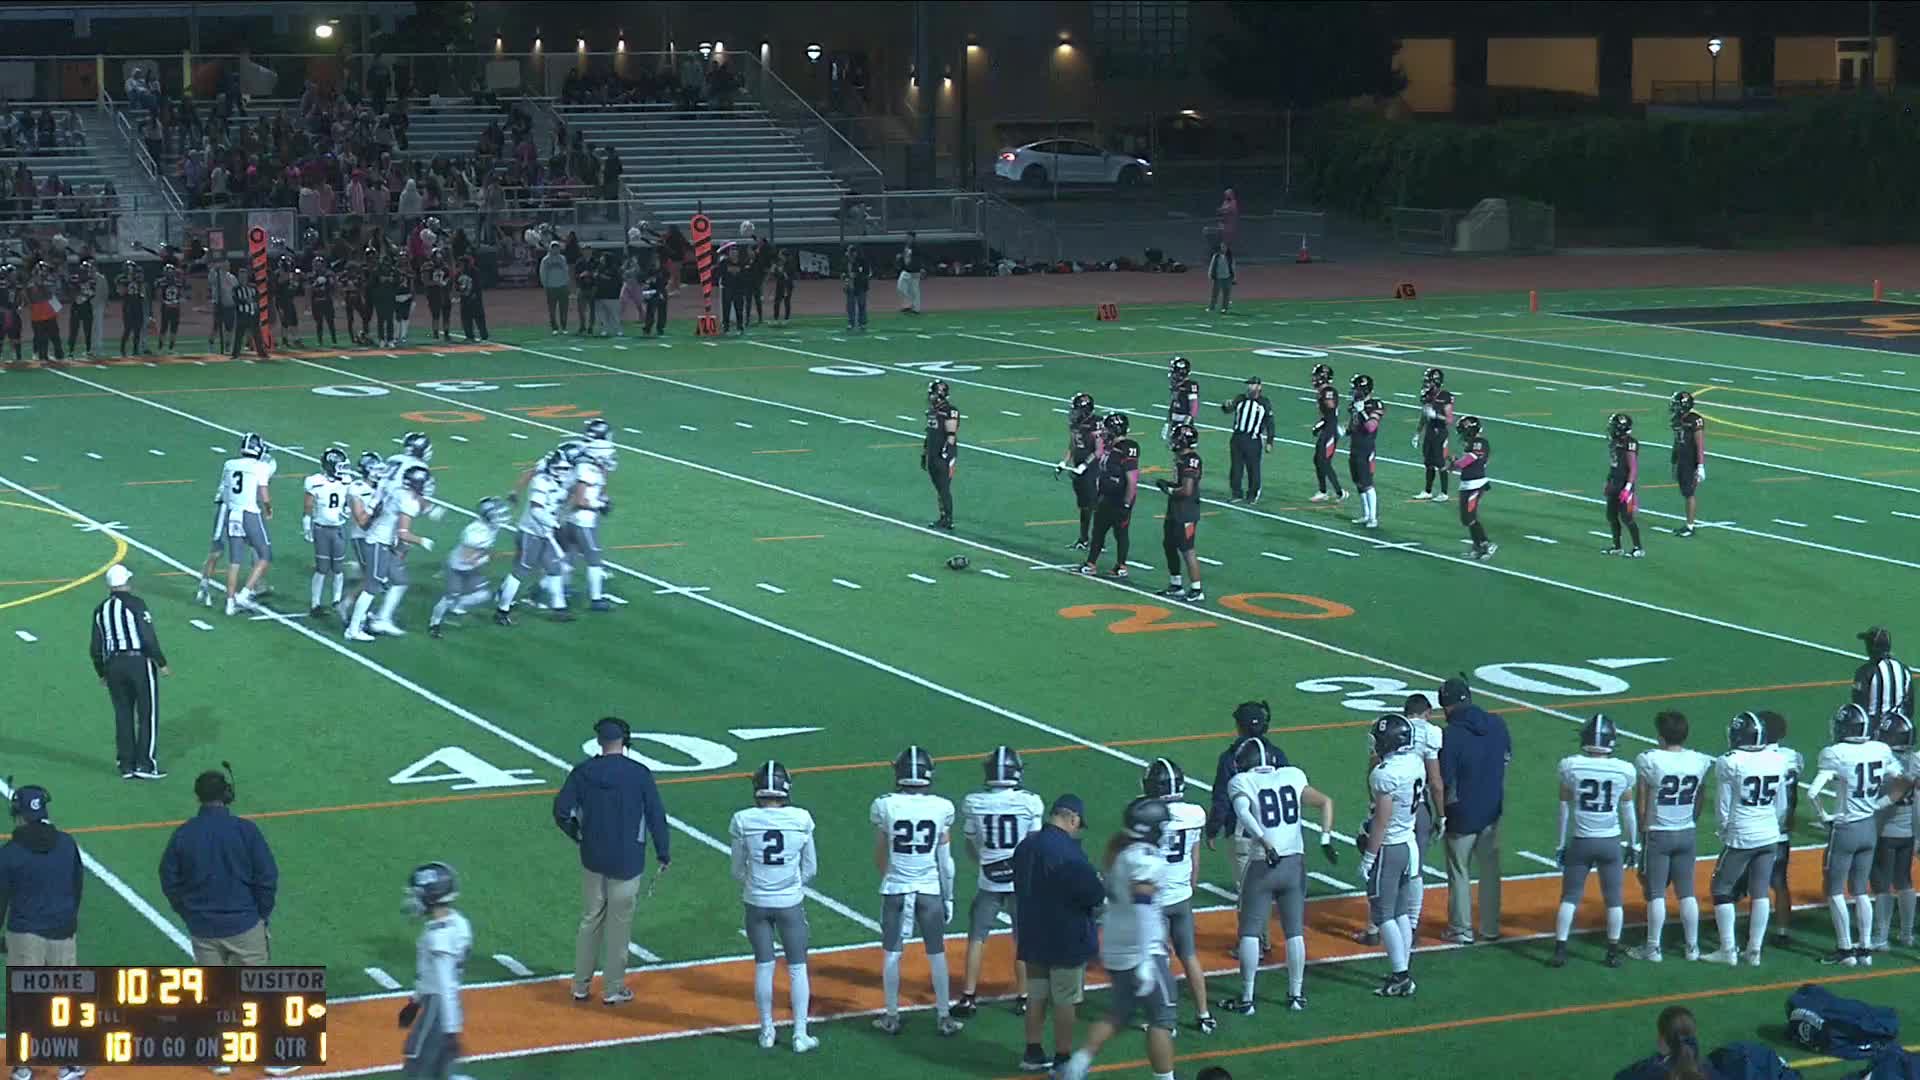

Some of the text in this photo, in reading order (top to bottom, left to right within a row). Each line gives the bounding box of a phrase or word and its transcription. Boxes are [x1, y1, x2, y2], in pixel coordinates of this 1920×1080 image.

[232, 470, 243, 494] 3
[1379, 719, 1387, 732] 6
[1580, 778, 1613, 812] 21
[1657, 775, 1699, 806] 22
[1741, 775, 1780, 806] 35
[1853, 760, 1883, 798] 15
[1257, 784, 1299, 828] 88
[762, 830, 785, 865] 2
[893, 819, 936, 854] 23
[983, 814, 1018, 850] 10
